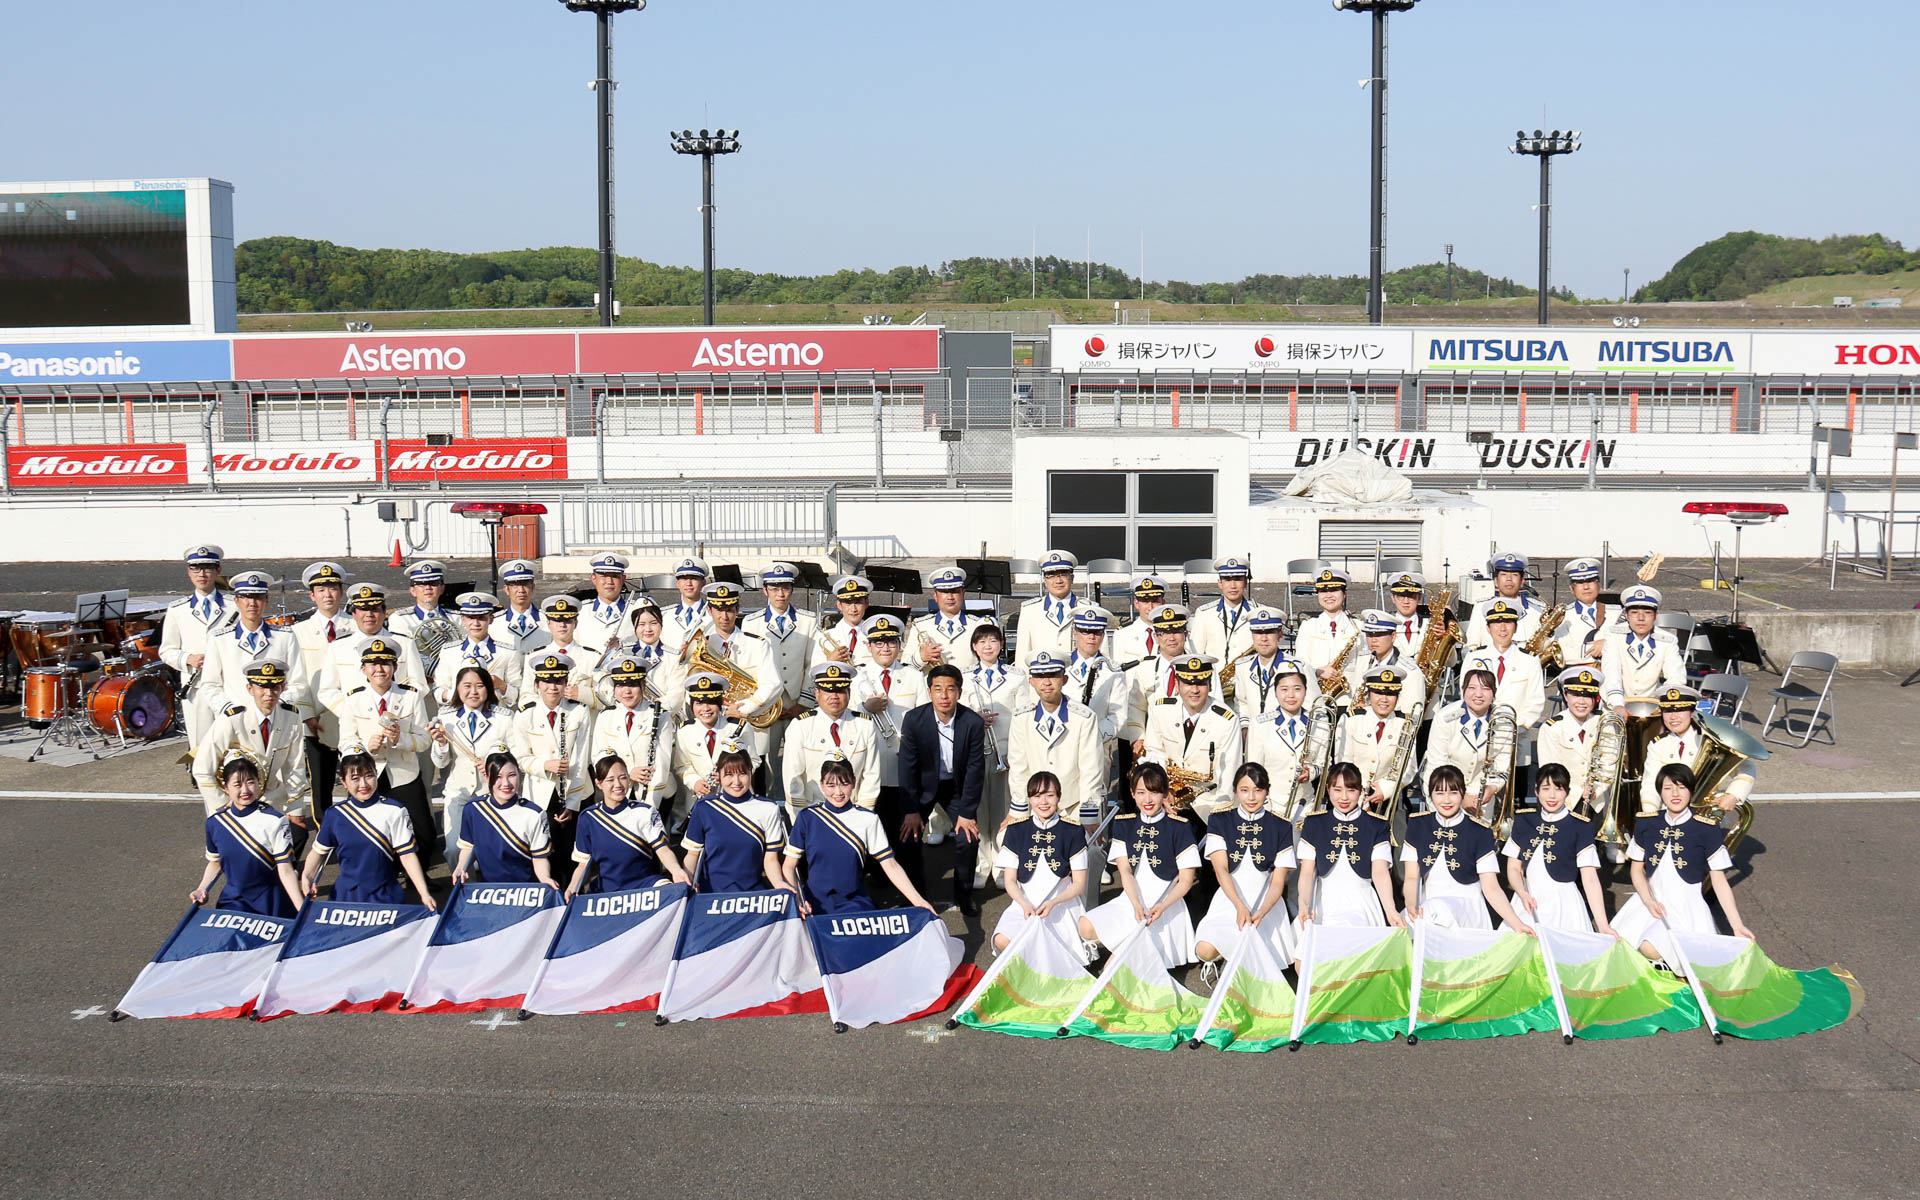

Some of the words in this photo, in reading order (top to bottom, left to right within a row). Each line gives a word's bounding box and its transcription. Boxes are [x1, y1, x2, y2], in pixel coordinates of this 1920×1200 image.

[134, 180, 186, 191] Panasonic
[339, 343, 467, 373] Astemo
[691, 337, 824, 368] Astemo
[1117, 342, 1217, 360] 損保ジャパン
[1287, 343, 1384, 360] 損保ジャパン
[1430, 339, 1569, 361] MITSUBA
[1598, 341, 1734, 363] MITSUBA
[1079, 360, 1111, 368] SOMPO
[1248, 360, 1280, 368] SOMPO
[18, 454, 176, 476] Modulo
[202, 451, 362, 472] Modulo
[388, 448, 554, 471] Modulo
